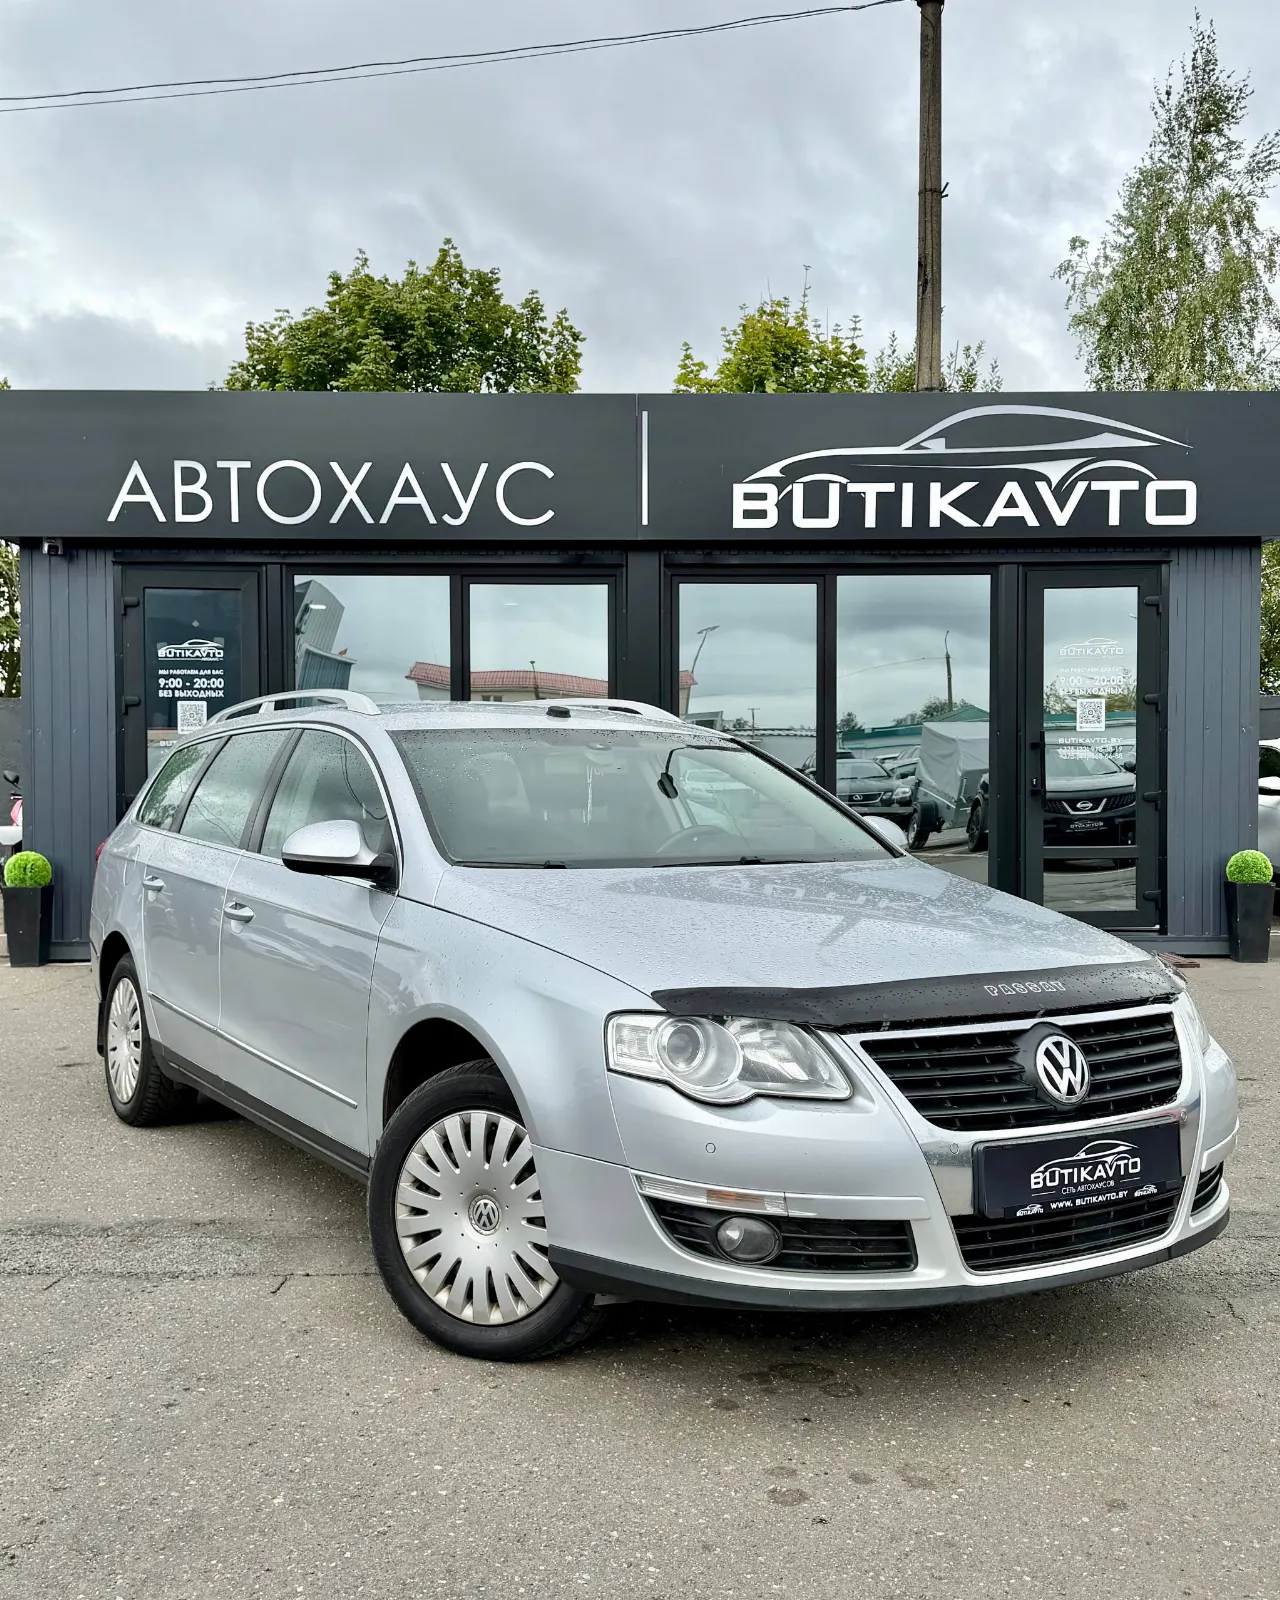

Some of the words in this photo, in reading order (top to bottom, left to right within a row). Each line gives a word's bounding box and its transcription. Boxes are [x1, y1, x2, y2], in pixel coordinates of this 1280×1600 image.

[107, 459, 555, 526] АВТОХАУС
[732, 480, 1197, 529] BUTIKAVTO
[158, 649, 224, 658] BUTIKAVTO
[1060, 647, 1124, 656] BUTIKAVTO
[158, 677, 183, 689] 9:00
[193, 677, 225, 689] 20:00
[1060, 676, 1083, 686] 9:00
[1094, 675, 1124, 686] 20:00
[158, 689, 173, 698] БЕЗ
[174, 689, 225, 699] ВЫХОДНЫХ
[984, 981, 1067, 996] PASSAT
[1030, 1157, 1141, 1189] BUTIKAVTO
[1061, 1186, 1076, 1194] СЕТЬ
[1077, 1180, 1115, 1192] АВТОХАУСОВ
